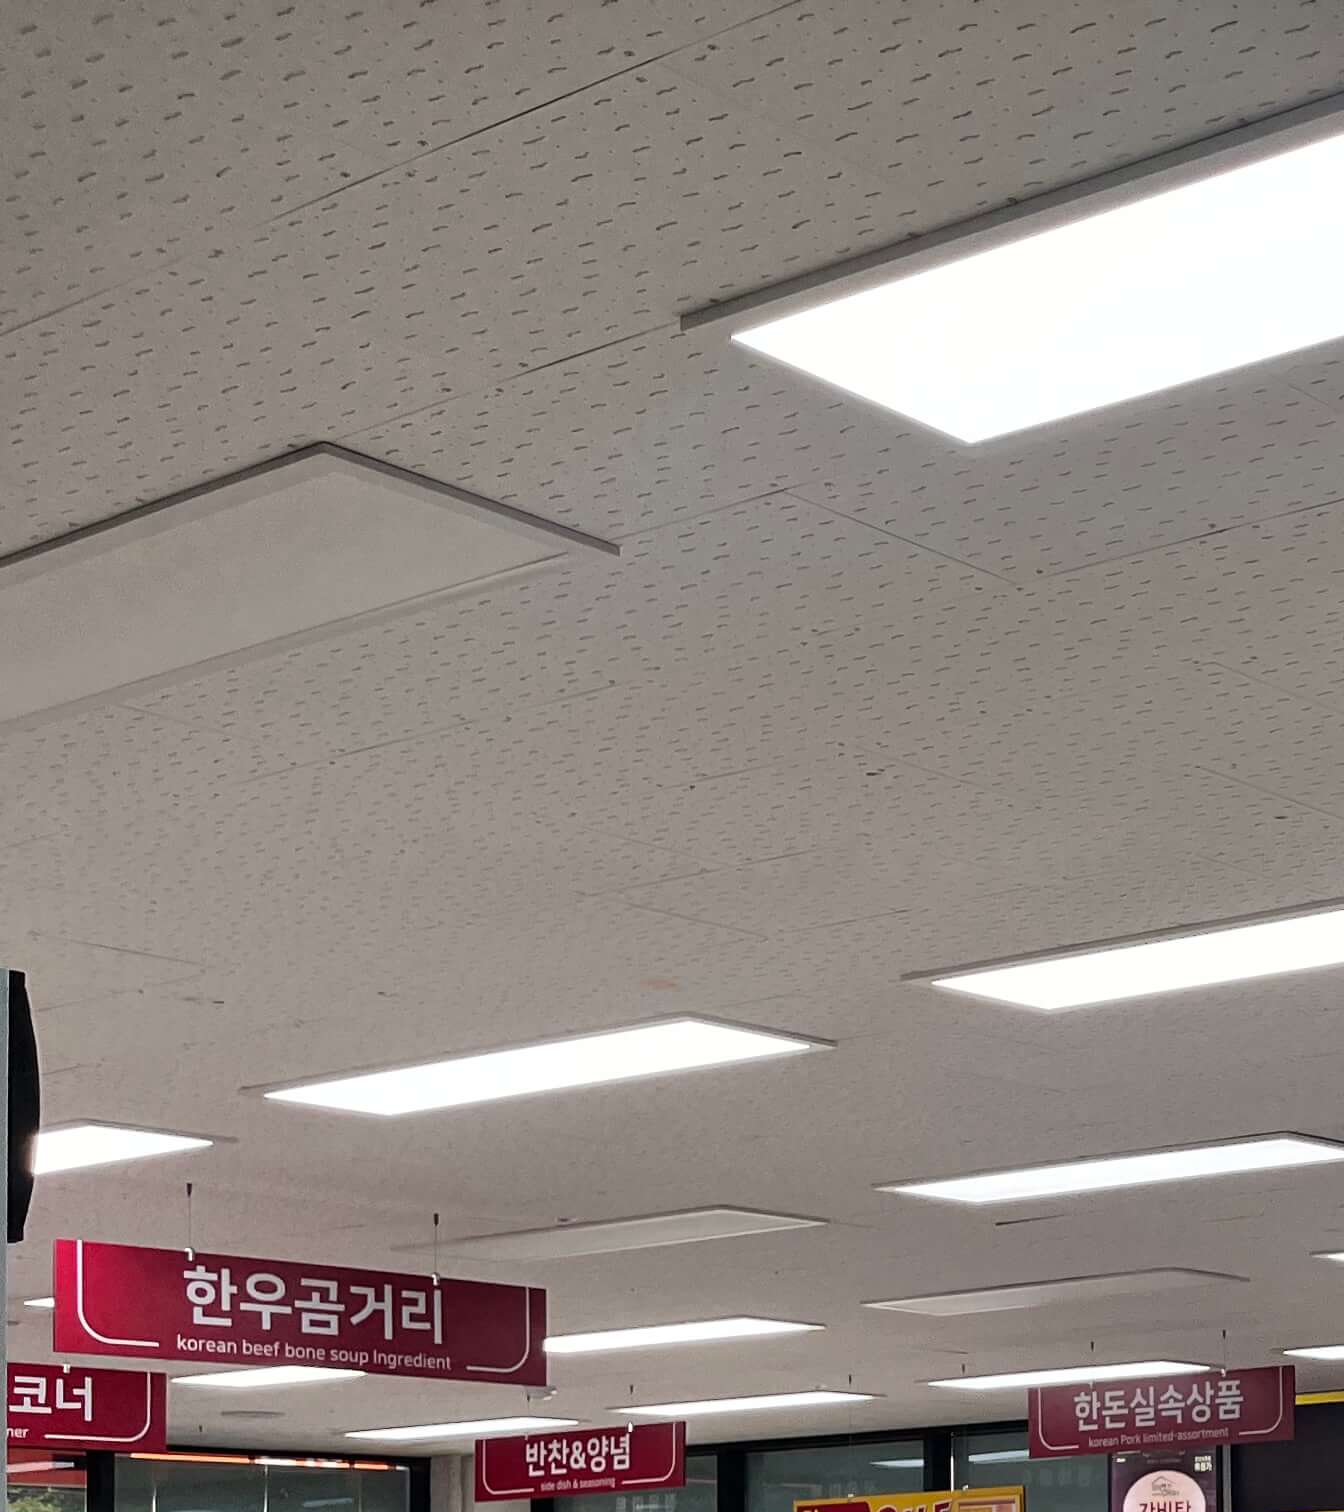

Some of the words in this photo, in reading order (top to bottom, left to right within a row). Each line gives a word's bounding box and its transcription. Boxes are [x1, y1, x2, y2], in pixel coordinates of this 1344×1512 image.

[183, 1265, 442, 1344] 한우곰거리
[176, 1333, 237, 1355] korean
[242, 1339, 280, 1356] beef
[285, 1341, 326, 1361] bone
[330, 1348, 369, 1366] soup
[373, 1351, 452, 1370] Ingredient
[9, 1375, 92, 1422] 코너
[1073, 1380, 1244, 1432] 한돈실속상품
[525, 1433, 630, 1477] 반찬&양념
[1089, 1435, 1119, 1448] korean
[1120, 1434, 1141, 1446] Pork
[540, 1481, 554, 1491] side
[556, 1480, 571, 1490] dish
[579, 1477, 616, 1489] seasoning
